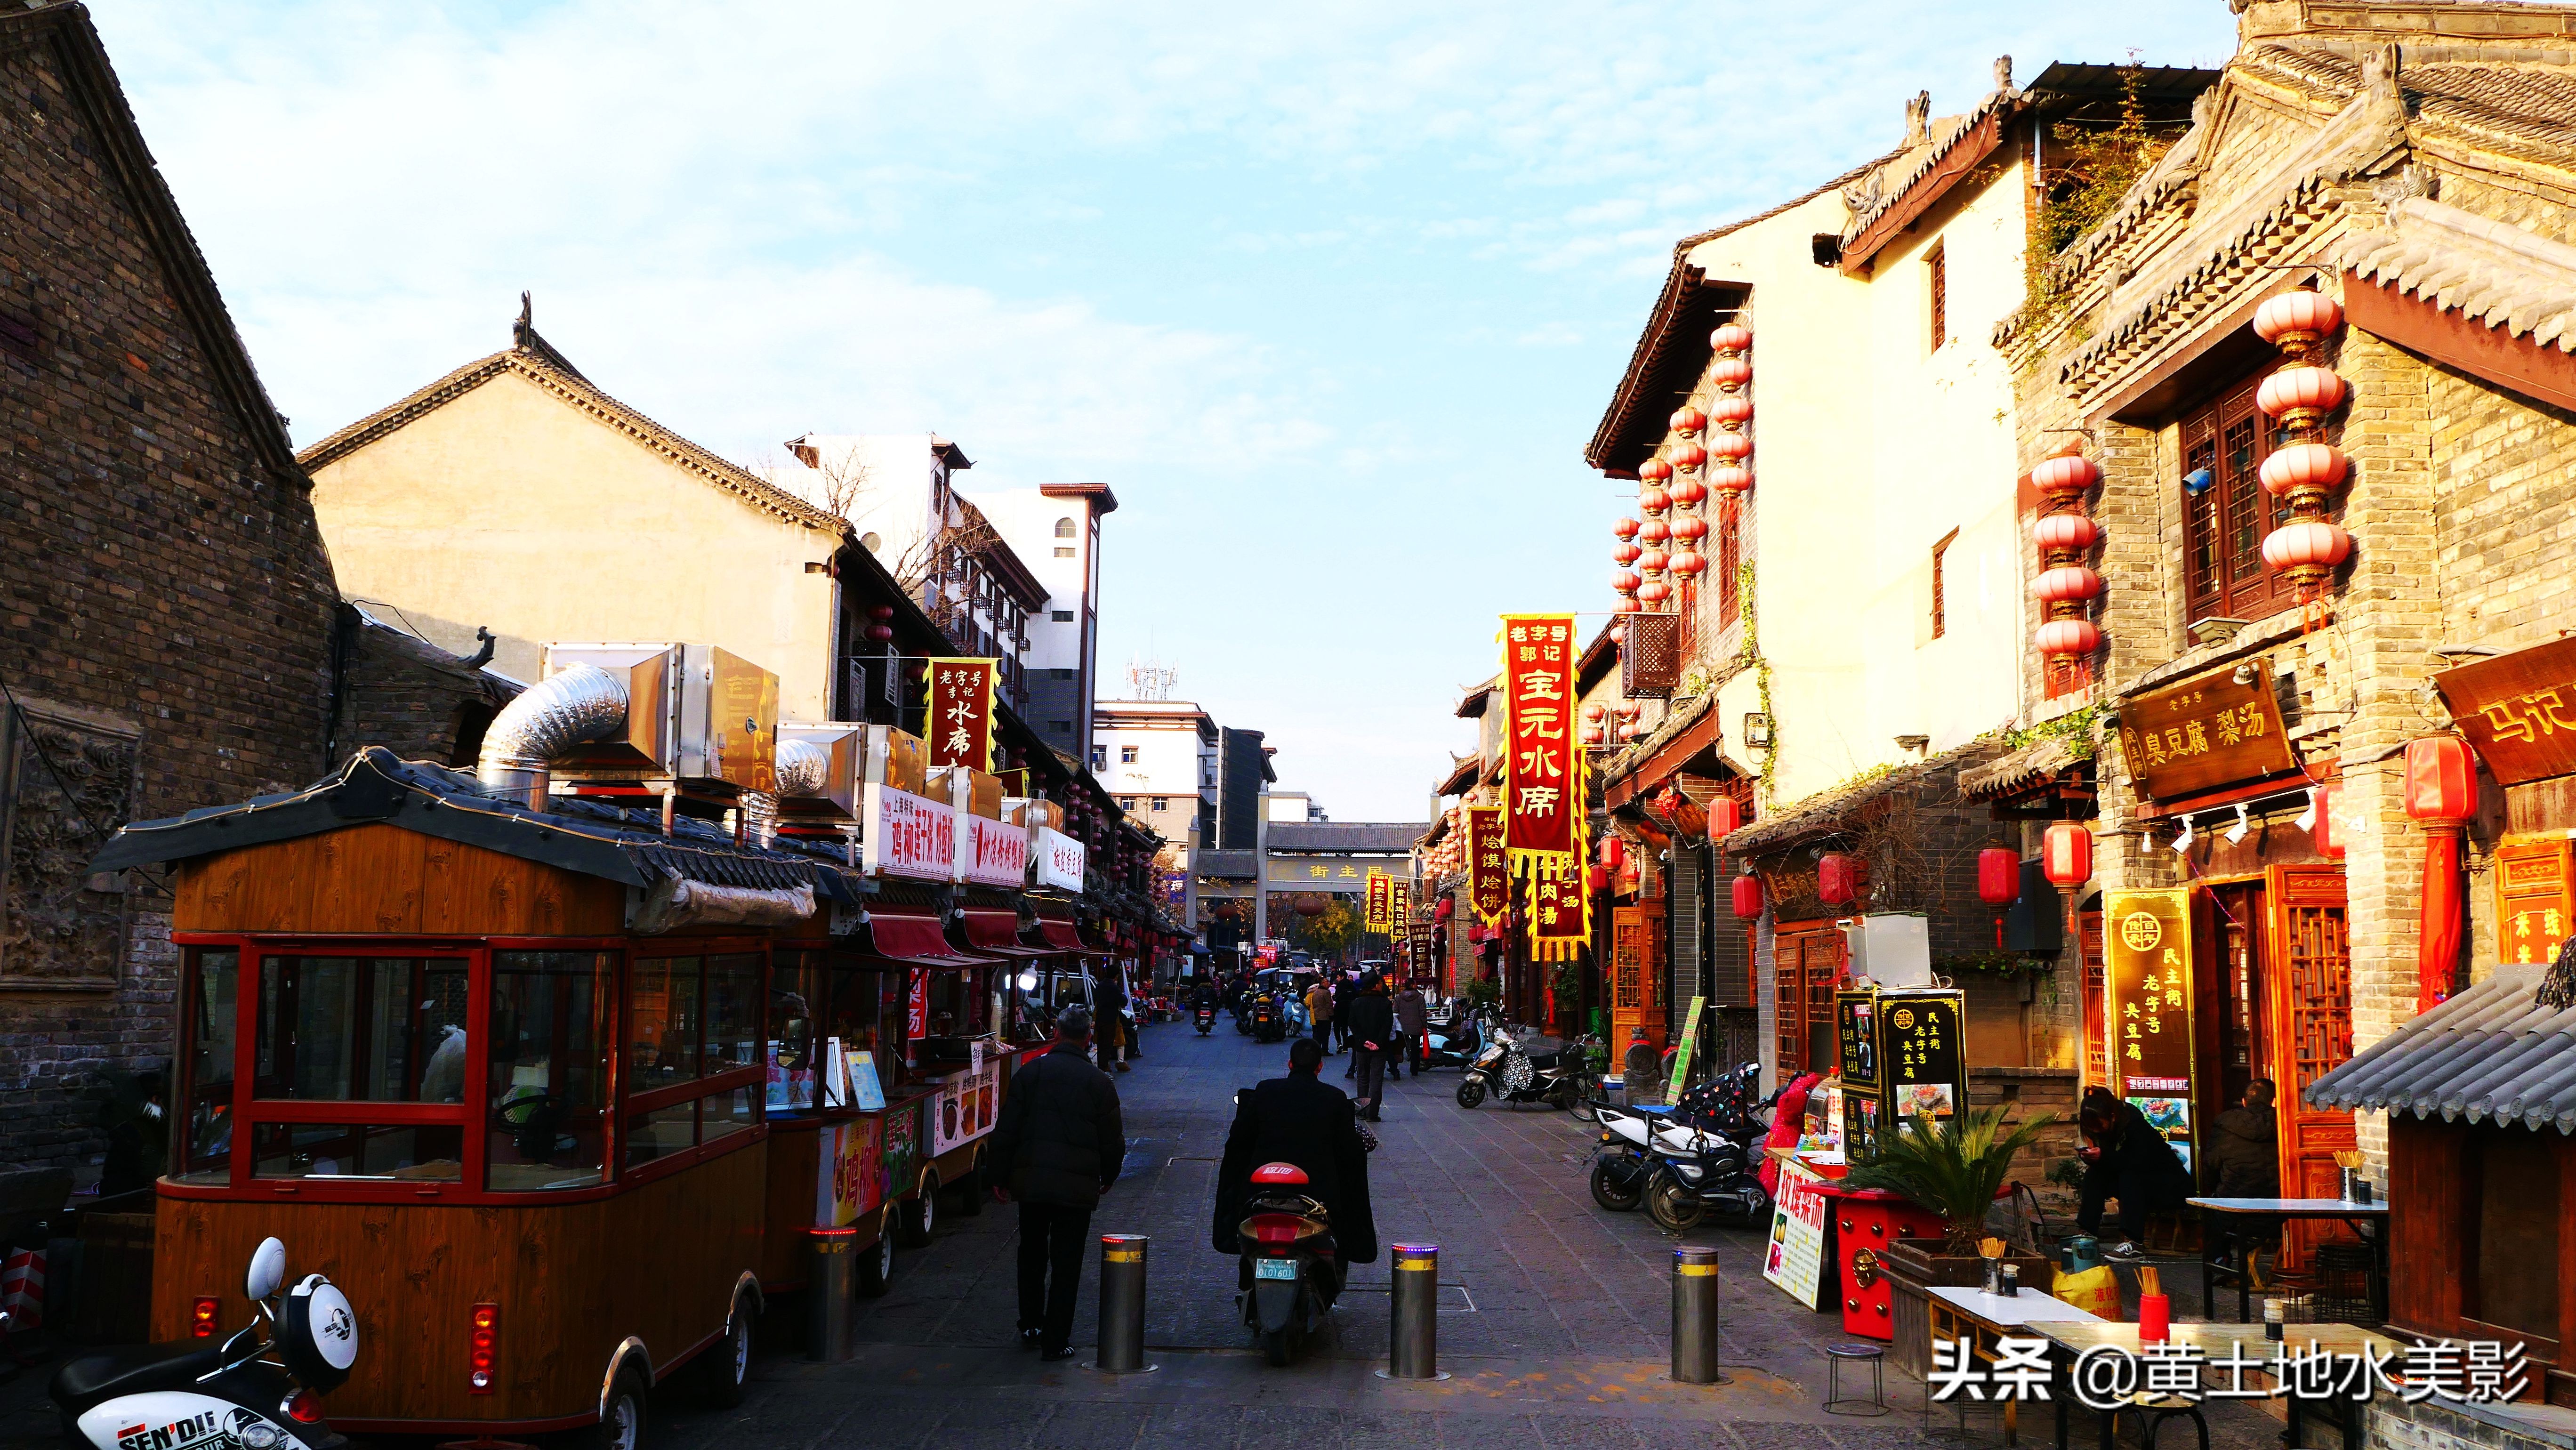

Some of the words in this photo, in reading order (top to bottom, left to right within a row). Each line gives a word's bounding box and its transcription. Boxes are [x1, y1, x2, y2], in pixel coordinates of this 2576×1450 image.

[1510, 625, 1568, 642] 老字号
[1520, 645, 1560, 662] 郭记
[940, 670, 982, 687] 老字号
[948, 686, 974, 699] 李记
[2169, 691, 2203, 711] 老字号
[2478, 690, 2576, 742] 马记
[943, 700, 978, 768] 水席
[1514, 669, 1563, 818] 宝元水席
[2127, 732, 2142, 773] 民主街
[2145, 719, 2209, 766] 臭豆腐
[2217, 701, 2265, 746] 梨汤
[892, 818, 913, 866] 鸡柳
[1480, 834, 1502, 909] 烩馍烩饼
[2515, 908, 2561, 938] 米线
[2163, 948, 2182, 1007] 民主街
[2142, 974, 2161, 1034] 老字号
[1914, 1025, 1927, 1064] 老字号
[1928, 1012, 1940, 1049] 民主街
[2123, 1001, 2142, 1061] 臭豆腐
[1901, 1040, 1915, 1079] 臭豆腐
